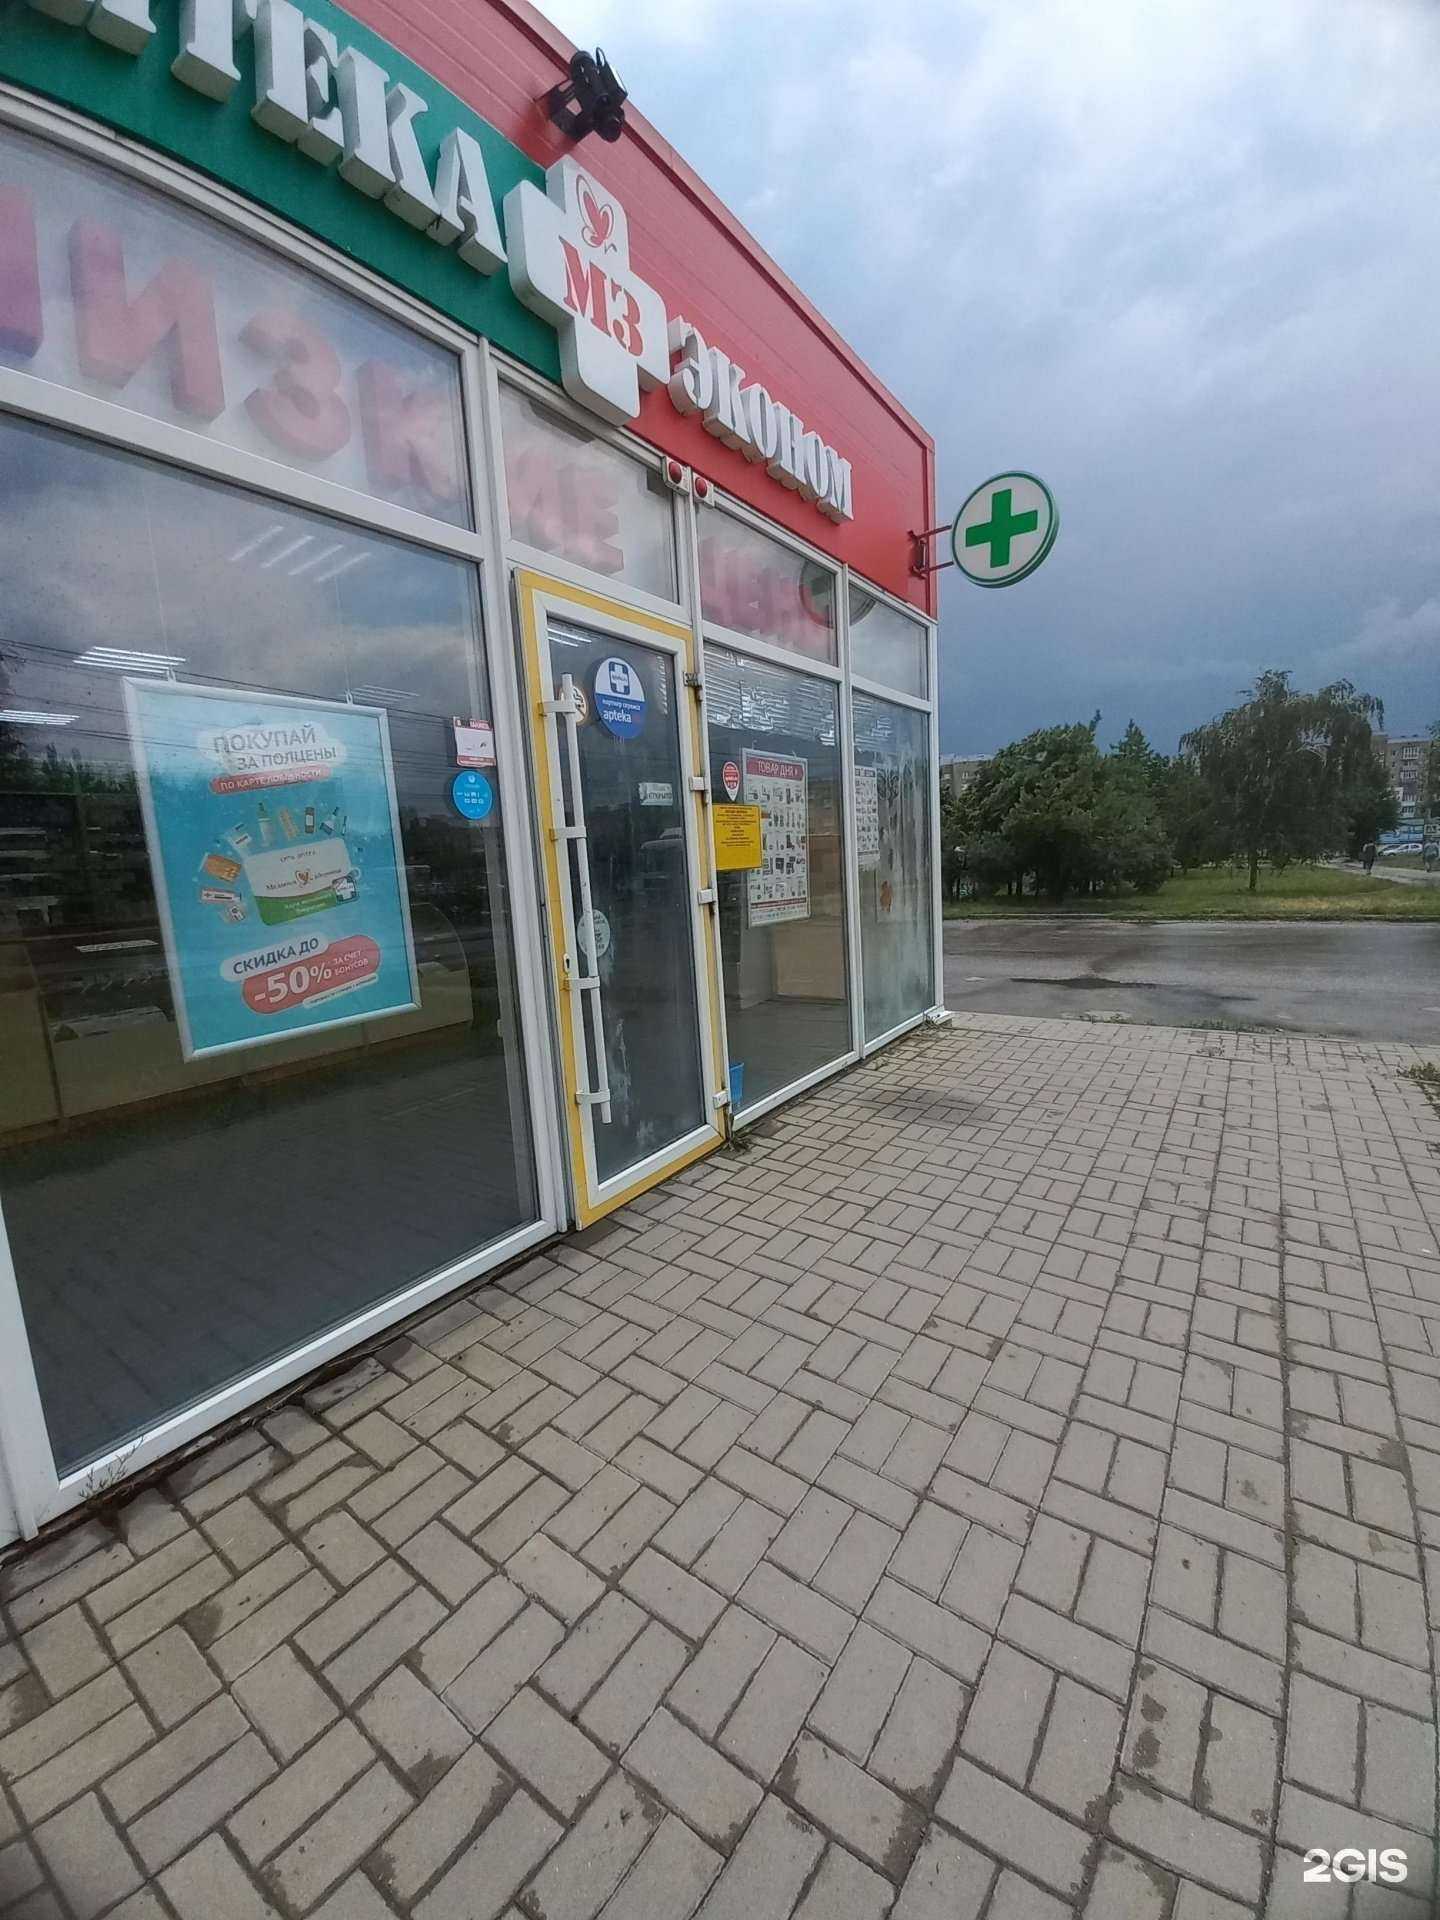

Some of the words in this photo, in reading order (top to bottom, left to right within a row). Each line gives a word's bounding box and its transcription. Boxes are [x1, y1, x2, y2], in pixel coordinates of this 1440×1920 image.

[669, 316, 854, 526] ЭКОНОМ
[213, 723, 316, 754] ПОКУПАЙ
[237, 757, 259, 771] ЗА
[262, 747, 337, 768] ПОЛЦЕНЫ
[759, 760, 779, 775] ТОВАР
[780, 764, 794, 777] ДНЯ
[219, 781, 235, 791] ПО
[236, 775, 265, 788] КАРТЕ
[233, 945, 297, 975] СКИДКА
[299, 938, 319, 955] ДО
[254, 962, 332, 1003] -50%
